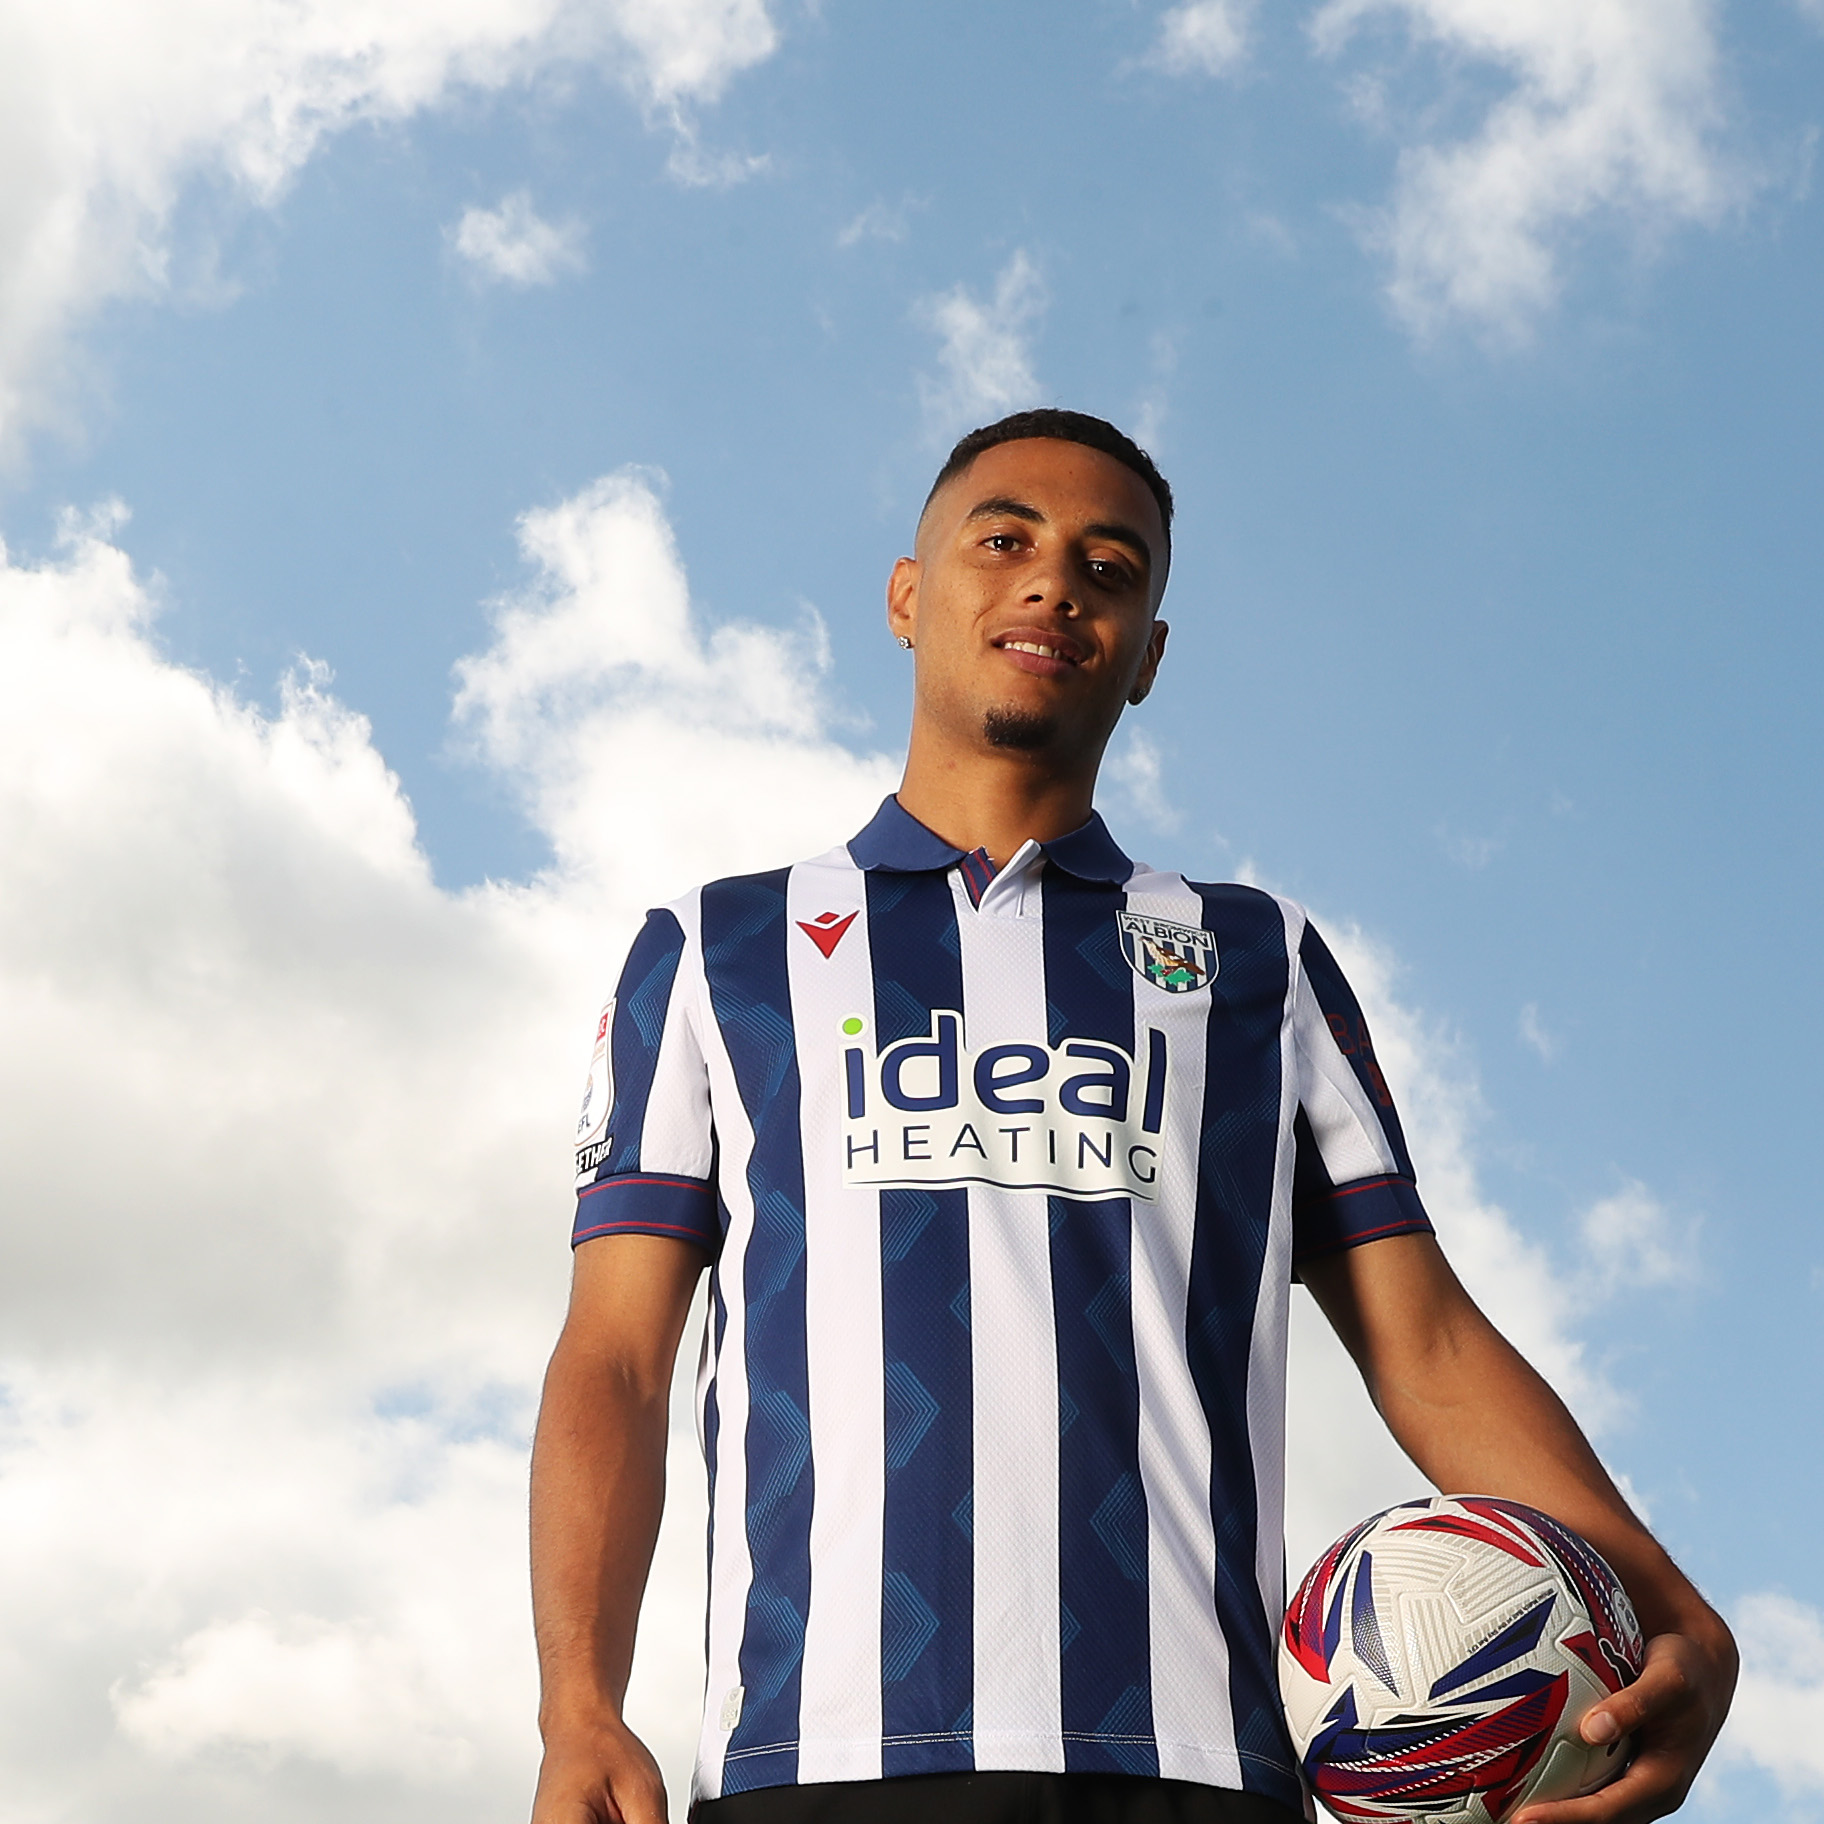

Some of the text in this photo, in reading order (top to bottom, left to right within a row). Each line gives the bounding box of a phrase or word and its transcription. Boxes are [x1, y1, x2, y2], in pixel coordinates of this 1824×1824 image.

[1126, 921, 1209, 948] ALBION
[842, 1014, 1167, 1134] ideal
[847, 1123, 1157, 1183] HEATING
